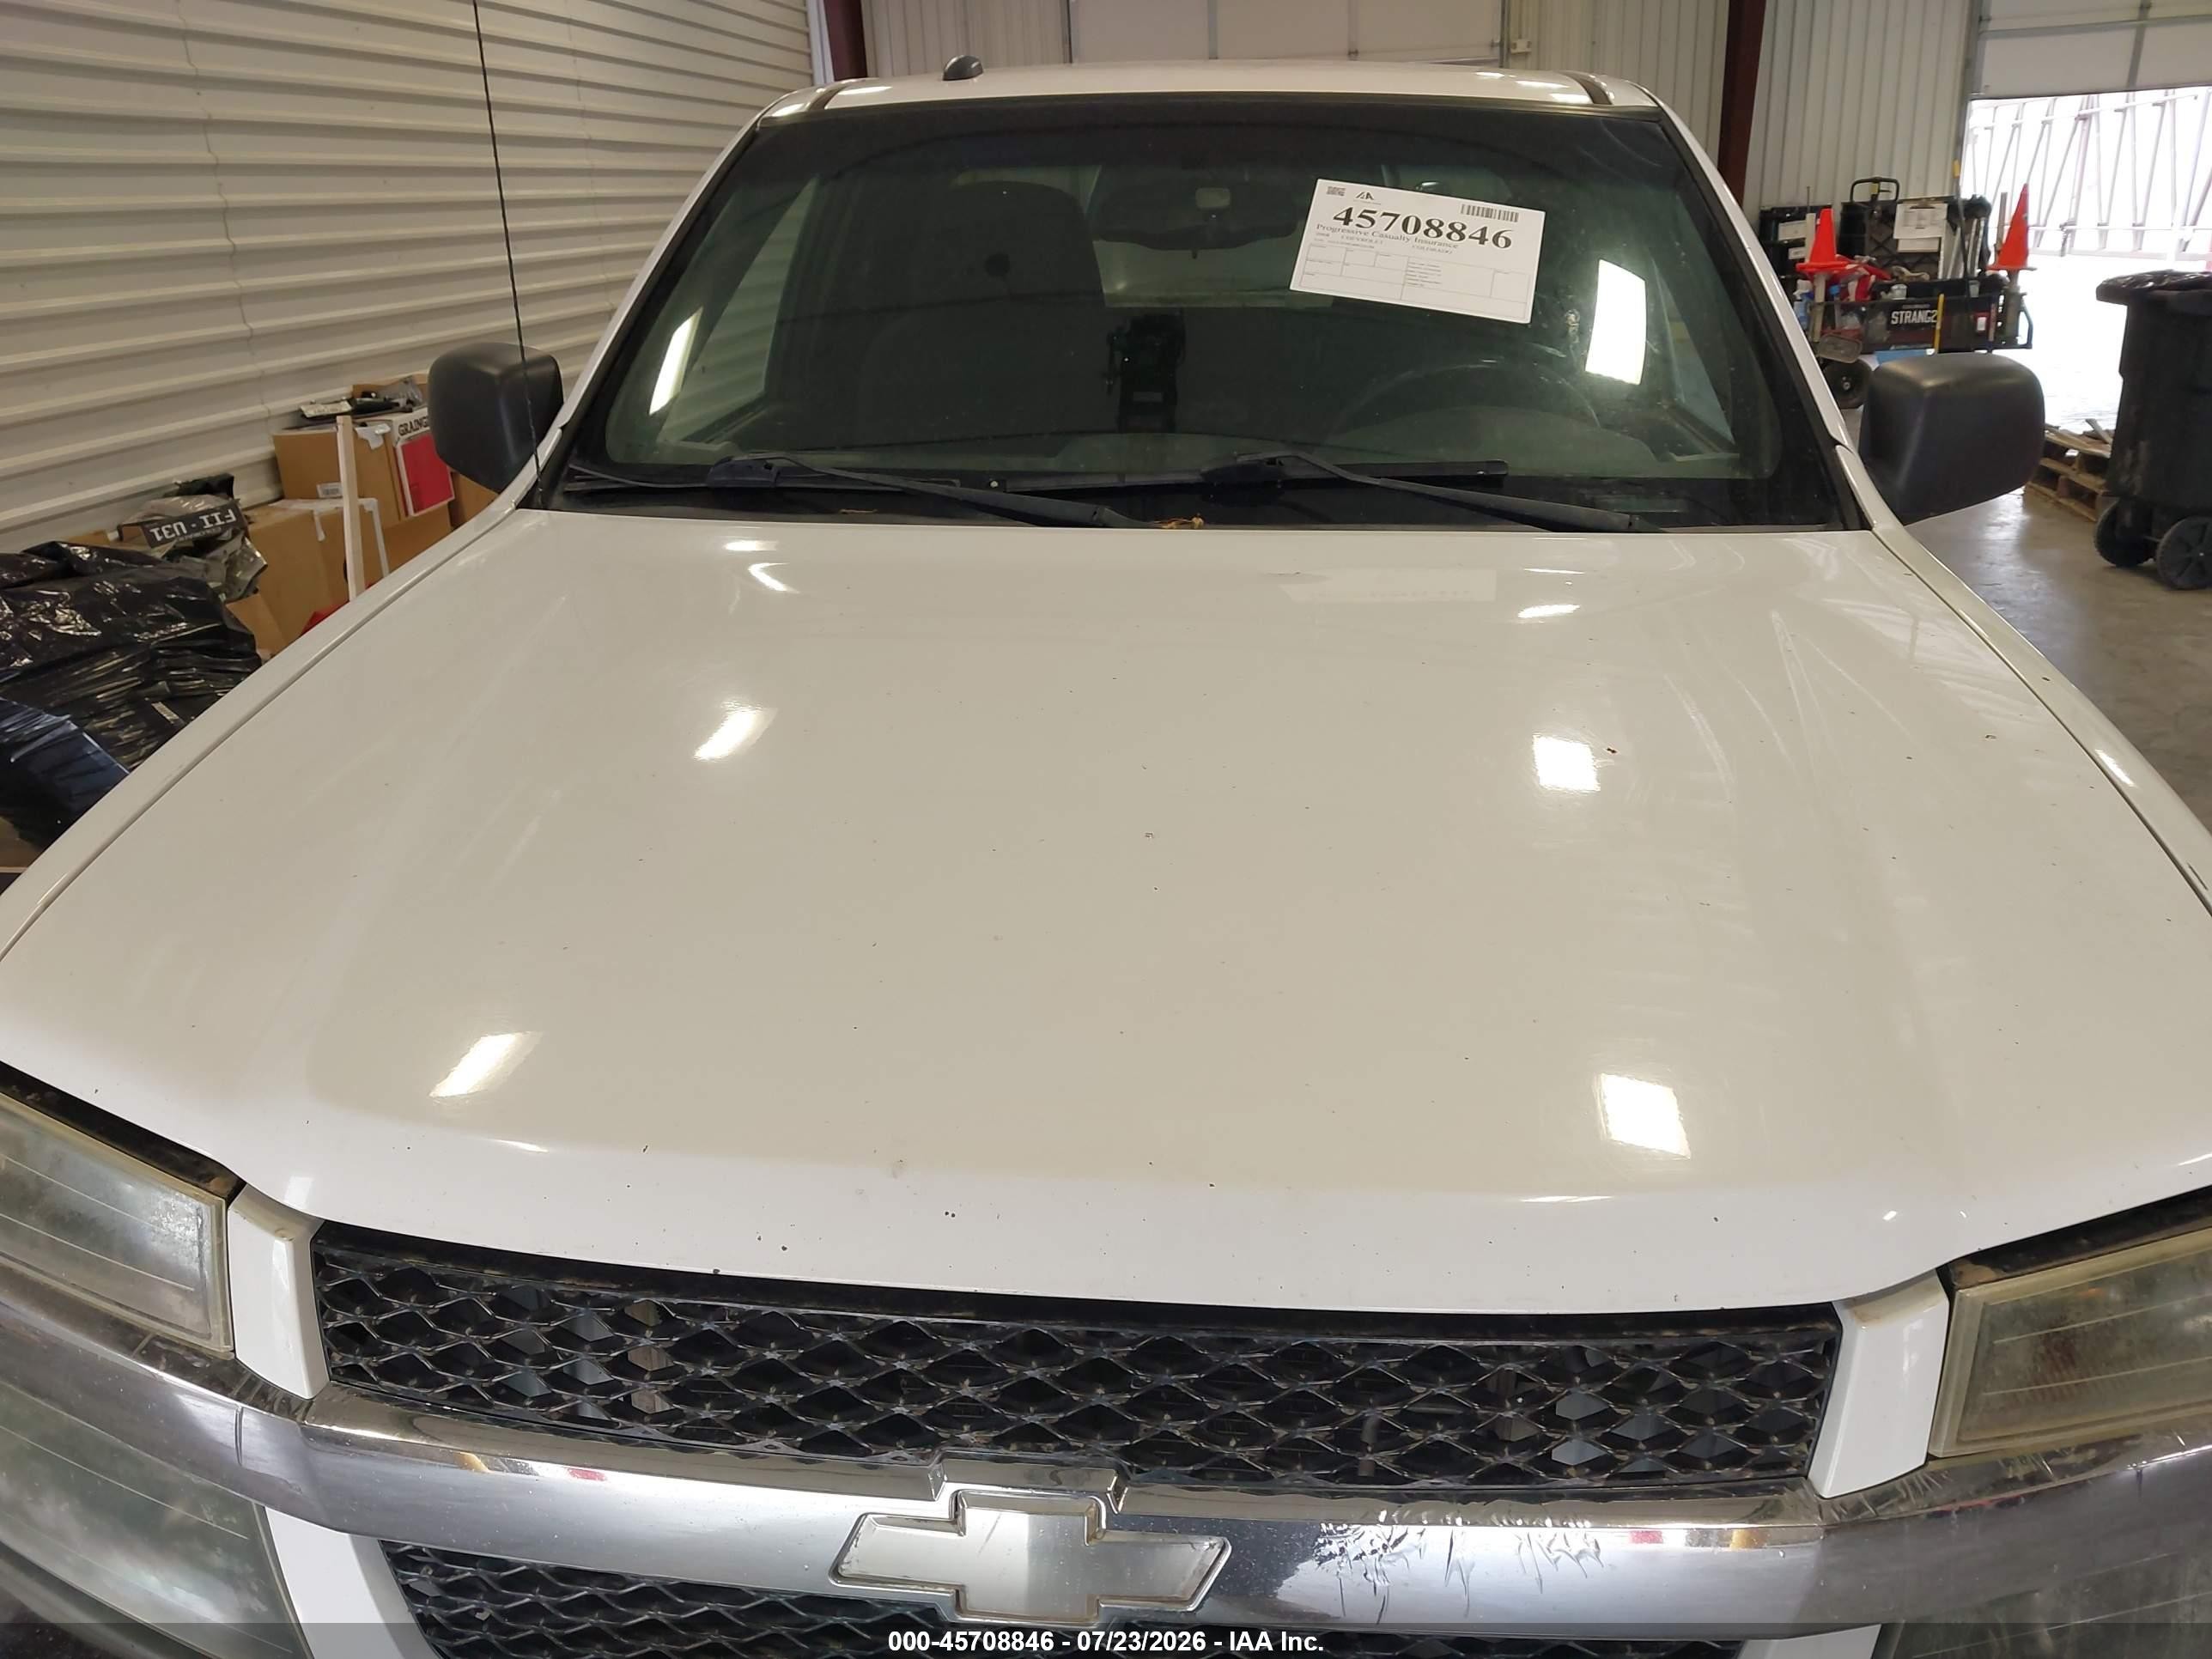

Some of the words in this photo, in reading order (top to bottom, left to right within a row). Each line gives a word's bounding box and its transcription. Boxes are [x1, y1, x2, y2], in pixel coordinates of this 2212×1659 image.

[1316, 223, 1370, 236] Progressive
[1371, 231, 1411, 243] Casualty
[1414, 237, 1459, 249] Insurance
[1333, 206, 1514, 248] 45708846
